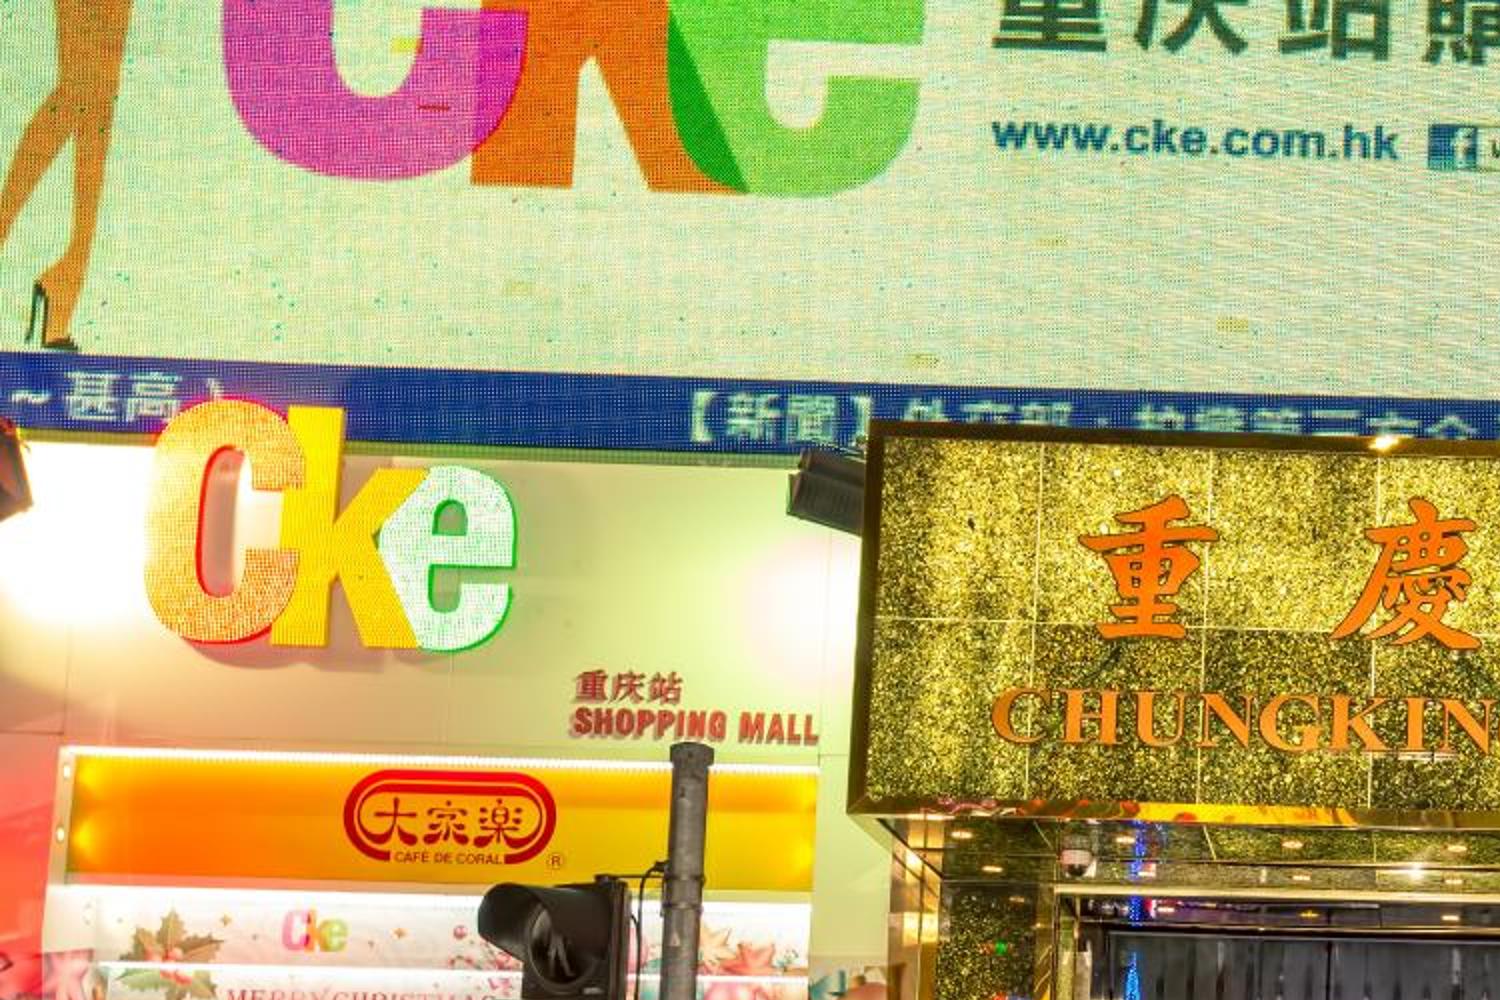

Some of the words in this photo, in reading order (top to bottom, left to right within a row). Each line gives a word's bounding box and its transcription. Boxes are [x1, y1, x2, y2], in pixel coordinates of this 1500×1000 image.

[991, 119, 1399, 161] www.cke.com.hk
[573, 669, 683, 704] 重庆站
[570, 706, 728, 742] SHOPPING
[738, 711, 820, 746] MALL
[434, 852, 453, 864] DE
[456, 853, 503, 866] CORAL
